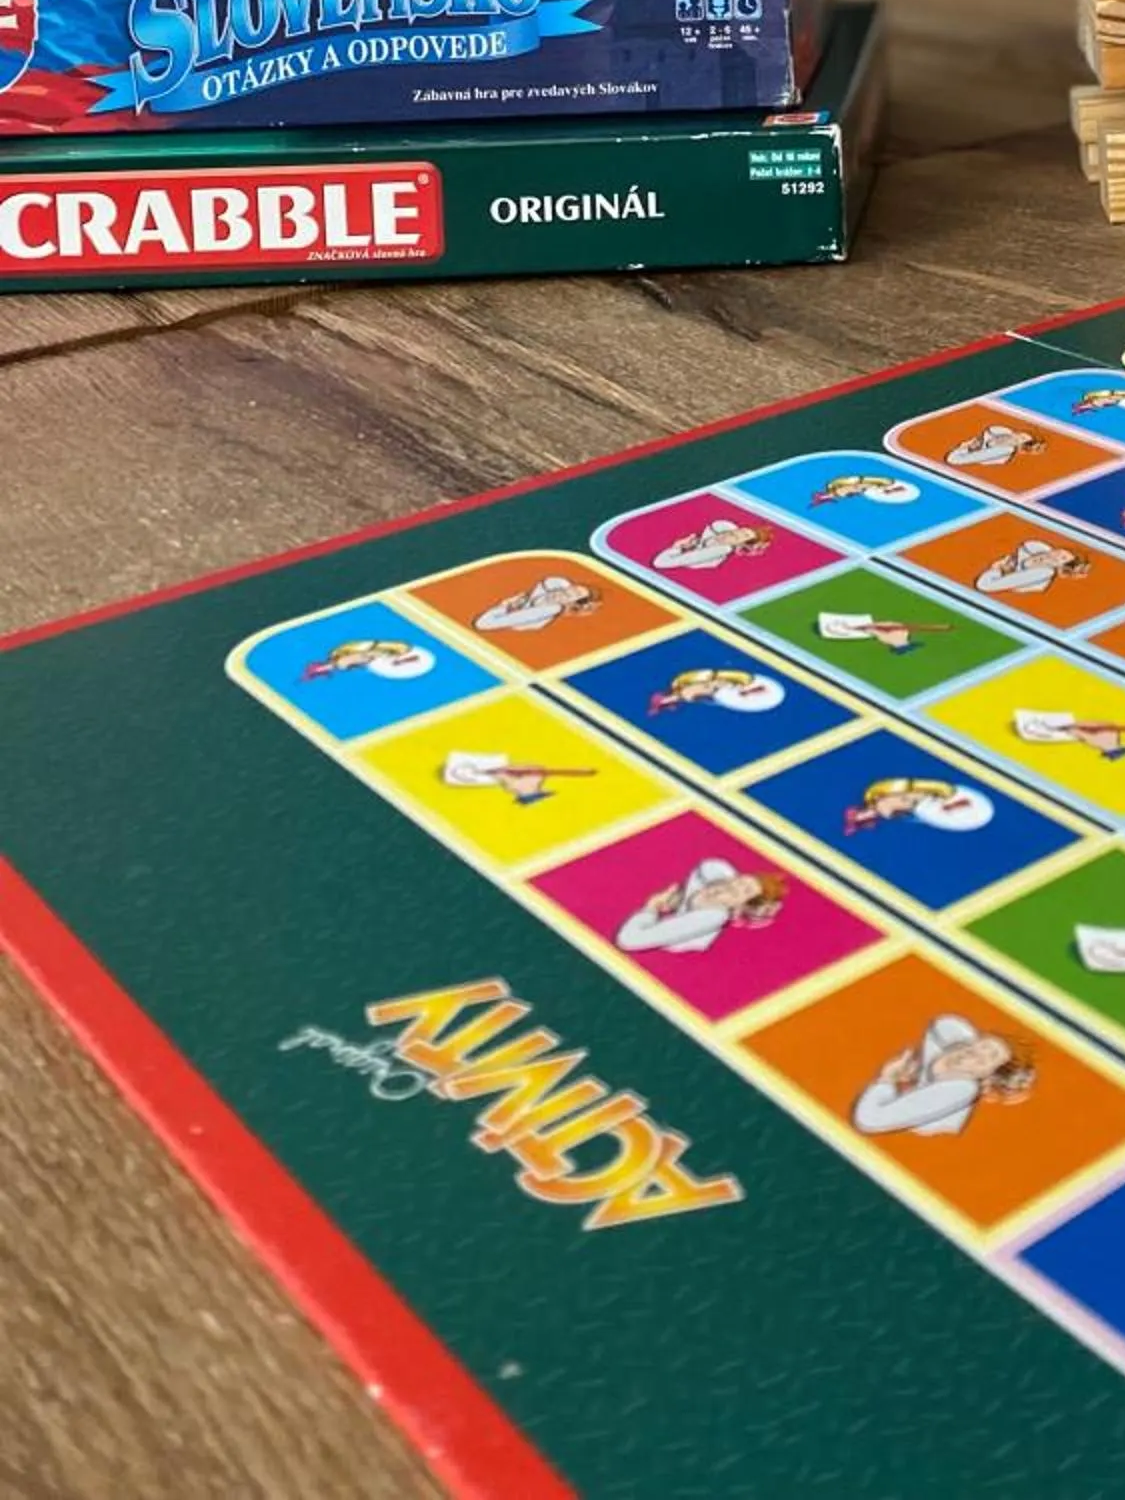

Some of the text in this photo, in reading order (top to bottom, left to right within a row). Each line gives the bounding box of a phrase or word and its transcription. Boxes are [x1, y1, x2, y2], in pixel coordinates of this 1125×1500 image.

[202, 31, 508, 101] OTÁZKY A ODPOVEDE
[412, 81, 658, 103] Zábavná hra pre zvedavých Slovákov
[489, 185, 666, 224] ORIGINÁL
[781, 181, 825, 195] 51292
[0, 182, 421, 259] CRABBLE
[366, 976, 745, 1232] ACTIVITY
